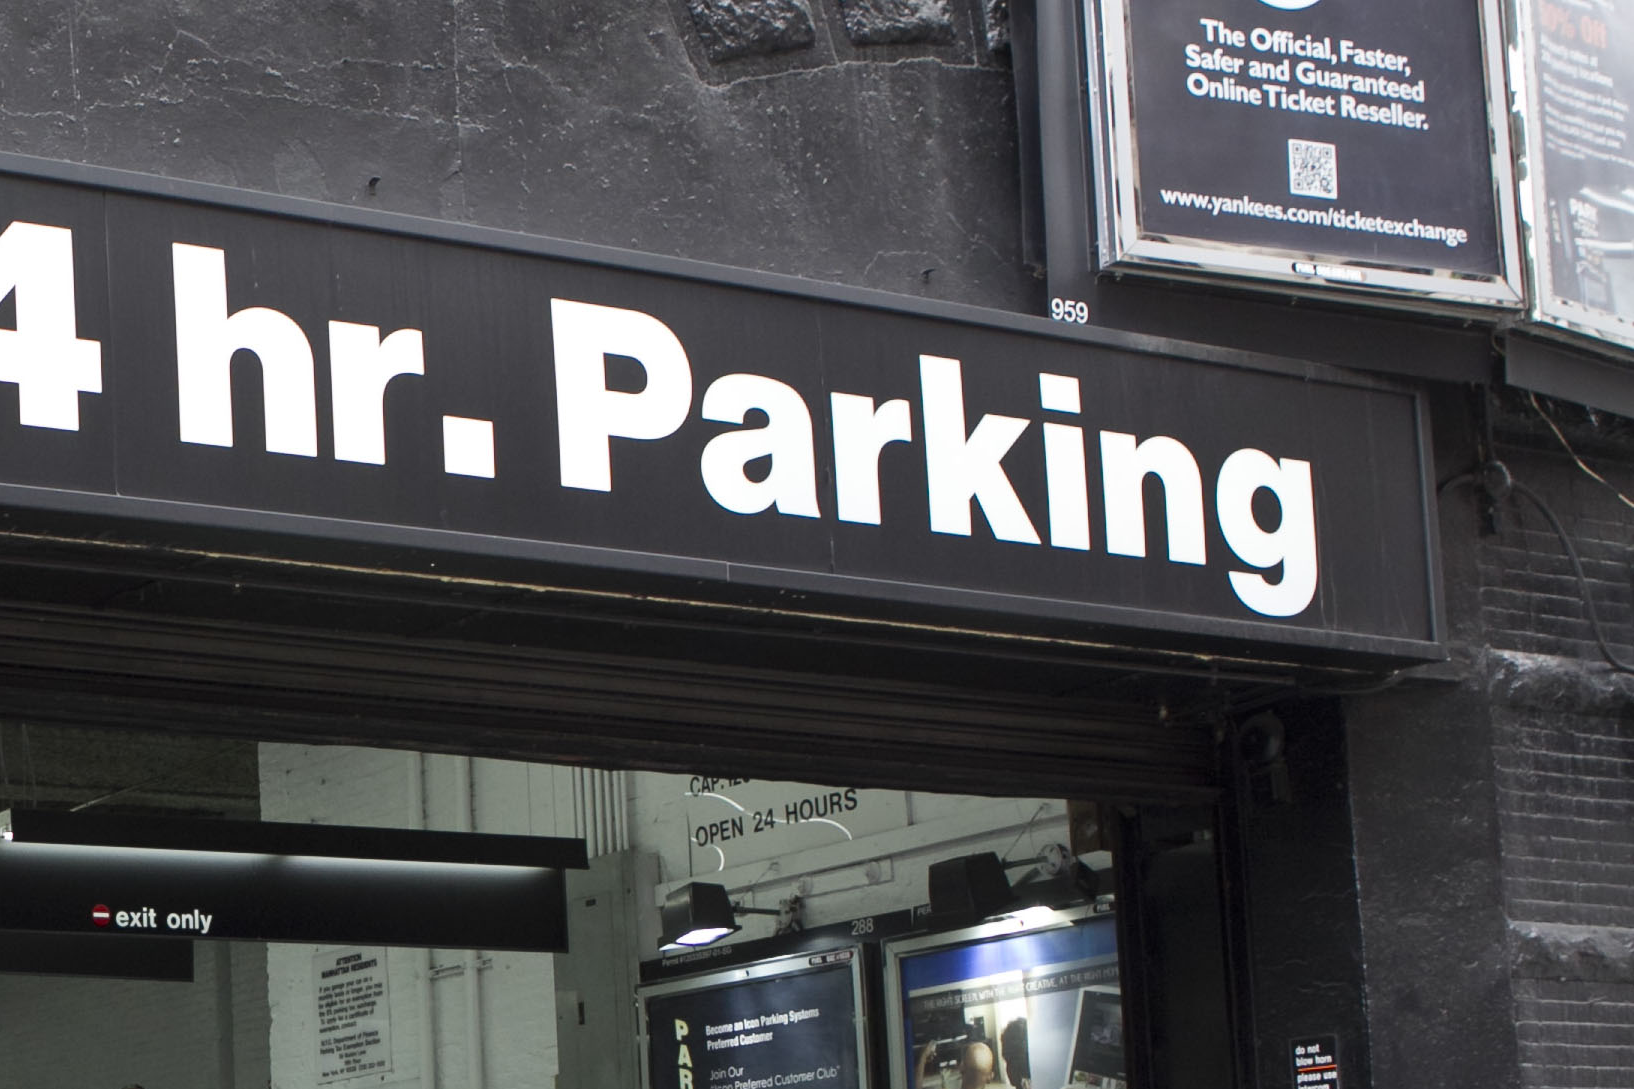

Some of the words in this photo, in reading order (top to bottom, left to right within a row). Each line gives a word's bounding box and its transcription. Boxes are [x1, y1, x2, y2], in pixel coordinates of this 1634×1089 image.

[1200, 18, 1246, 48] The
[1250, 28, 1338, 65] Official,
[1339, 39, 1412, 77] Faster,
[1185, 44, 1244, 74] Safer
[1248, 60, 1290, 82] and
[1295, 61, 1425, 103] Guaranteed
[1186, 73, 1262, 105] Online
[1262, 83, 1336, 116] Ticket
[1340, 95, 1429, 131] Reseller.
[1160, 189, 1467, 247] www.yankees.com/ticketexchange
[1051, 297, 1089, 324] 959
[171, 241, 497, 481] hr.
[550, 297, 1320, 618] Parking
[695, 816, 744, 847] OPEN
[753, 808, 775, 833] 24
[785, 788, 858, 824] HOURS
[115, 907, 157, 928] exit
[167, 909, 213, 934] only
[851, 917, 874, 936] 288
[705, 1024, 733, 1036] Become
[734, 1023, 743, 1032] an
[744, 1018, 760, 1030] Icon
[760, 1013, 788, 1027] Parking
[788, 1008, 820, 1023] Systems
[707, 1036, 739, 1051] Preferred
[740, 1031, 773, 1046] Customer
[1295, 1045, 1305, 1055] do
[1307, 1044, 1320, 1053] not
[710, 1068, 726, 1081] Join
[728, 1066, 745, 1078] Our
[1296, 1056, 1313, 1067] blow
[1315, 1055, 1332, 1064] horn
[774, 1070, 815, 1086] Customer
[1297, 1072, 1321, 1084] please
[1323, 1071, 1337, 1079] use
